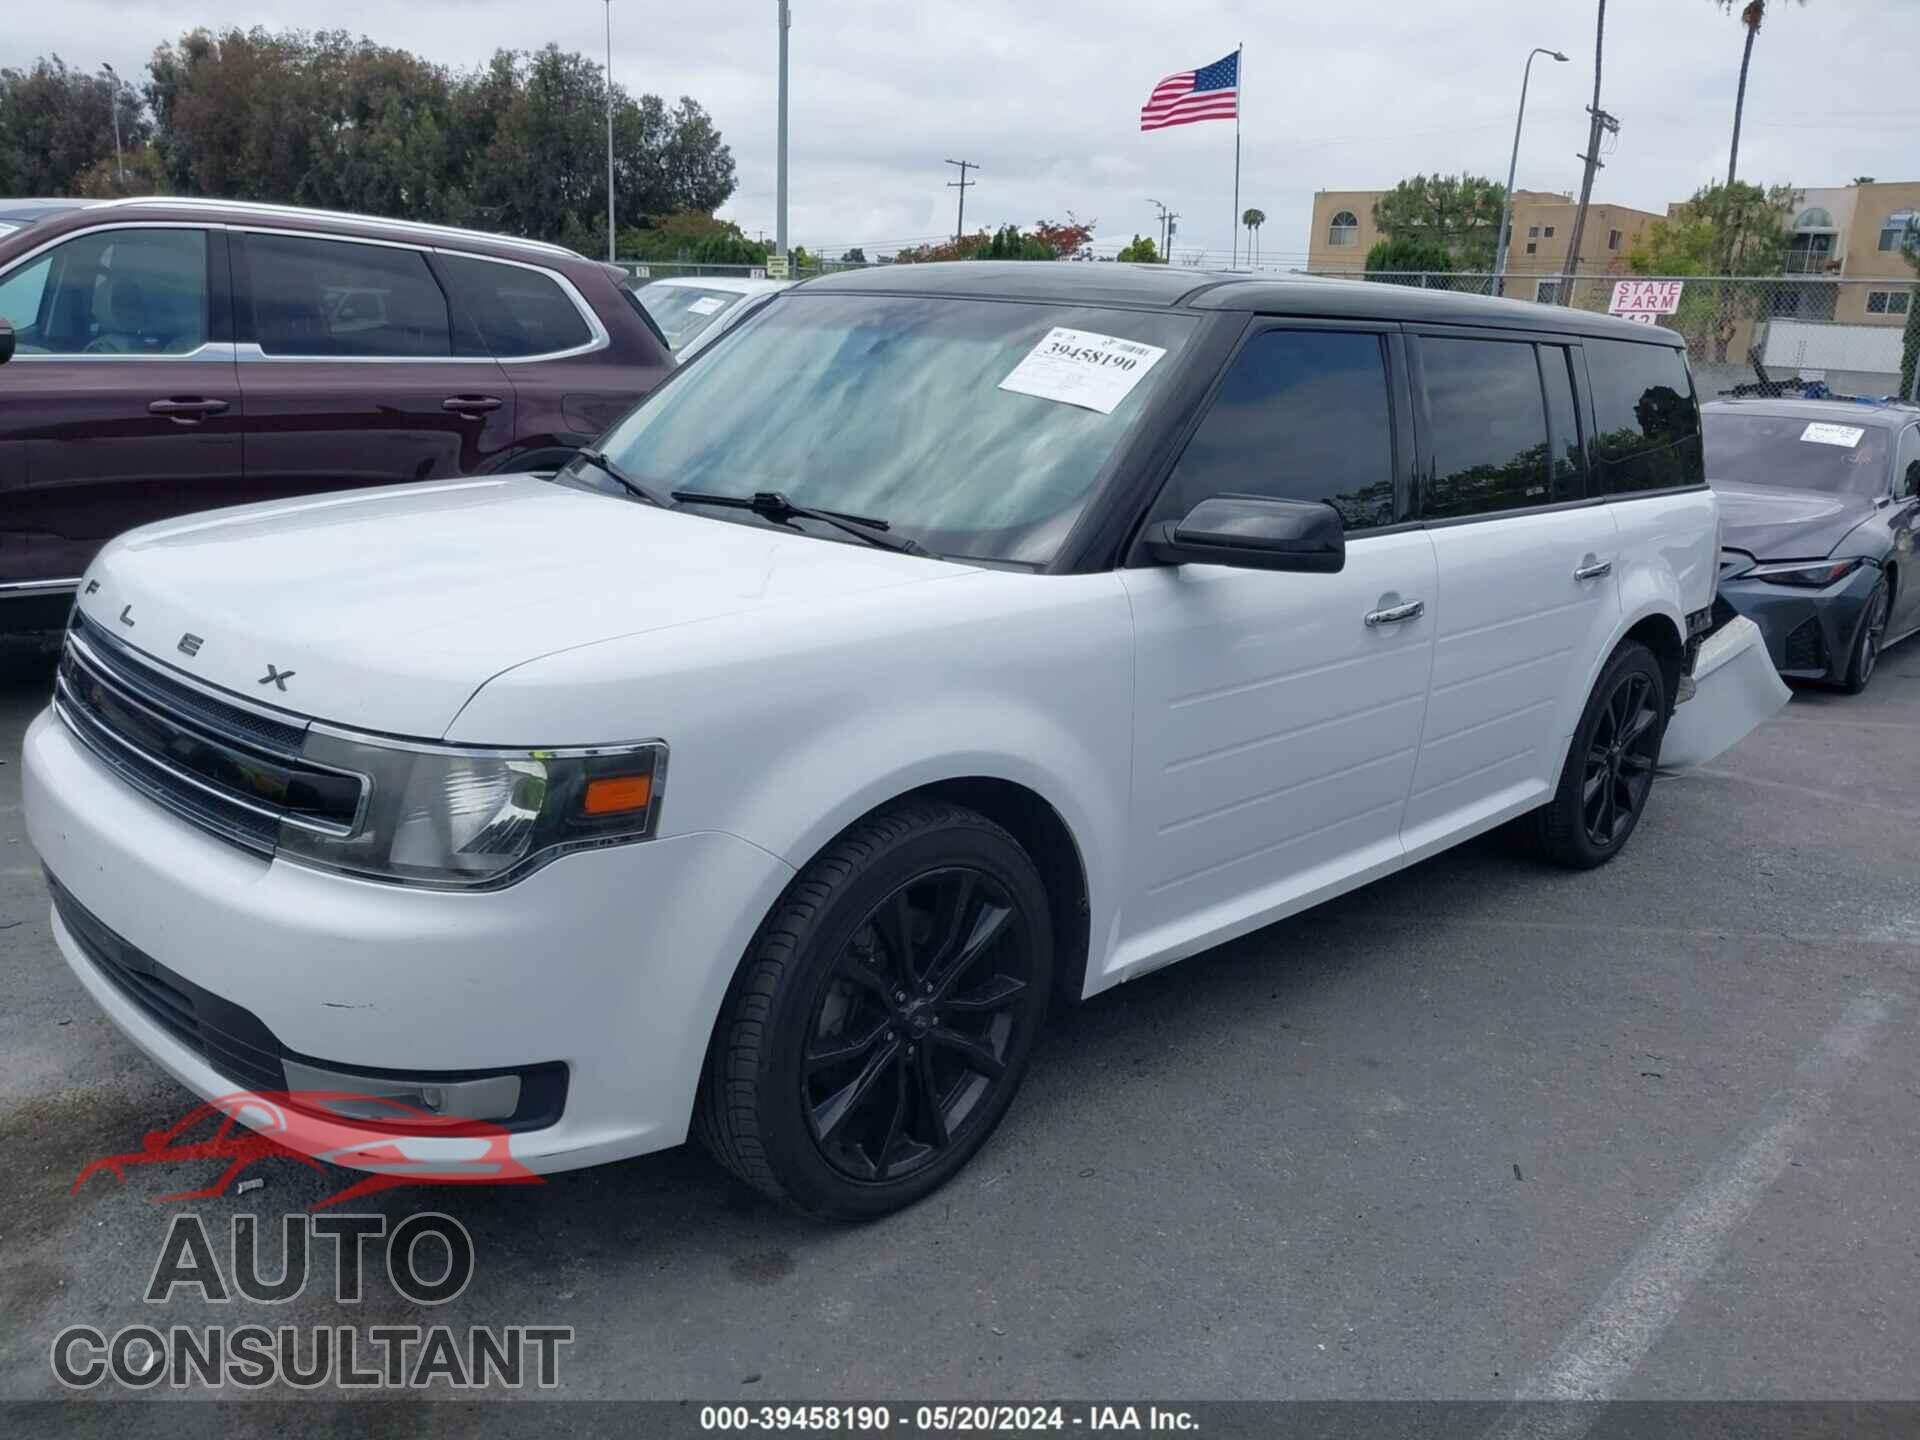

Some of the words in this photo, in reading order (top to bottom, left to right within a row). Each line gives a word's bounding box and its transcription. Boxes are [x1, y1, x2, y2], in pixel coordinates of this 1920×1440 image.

[1618, 282, 1681, 294] STATE
[1617, 295, 1674, 309] FARM
[1044, 341, 1137, 371] 39458190
[84, 579, 297, 692] FLEX
